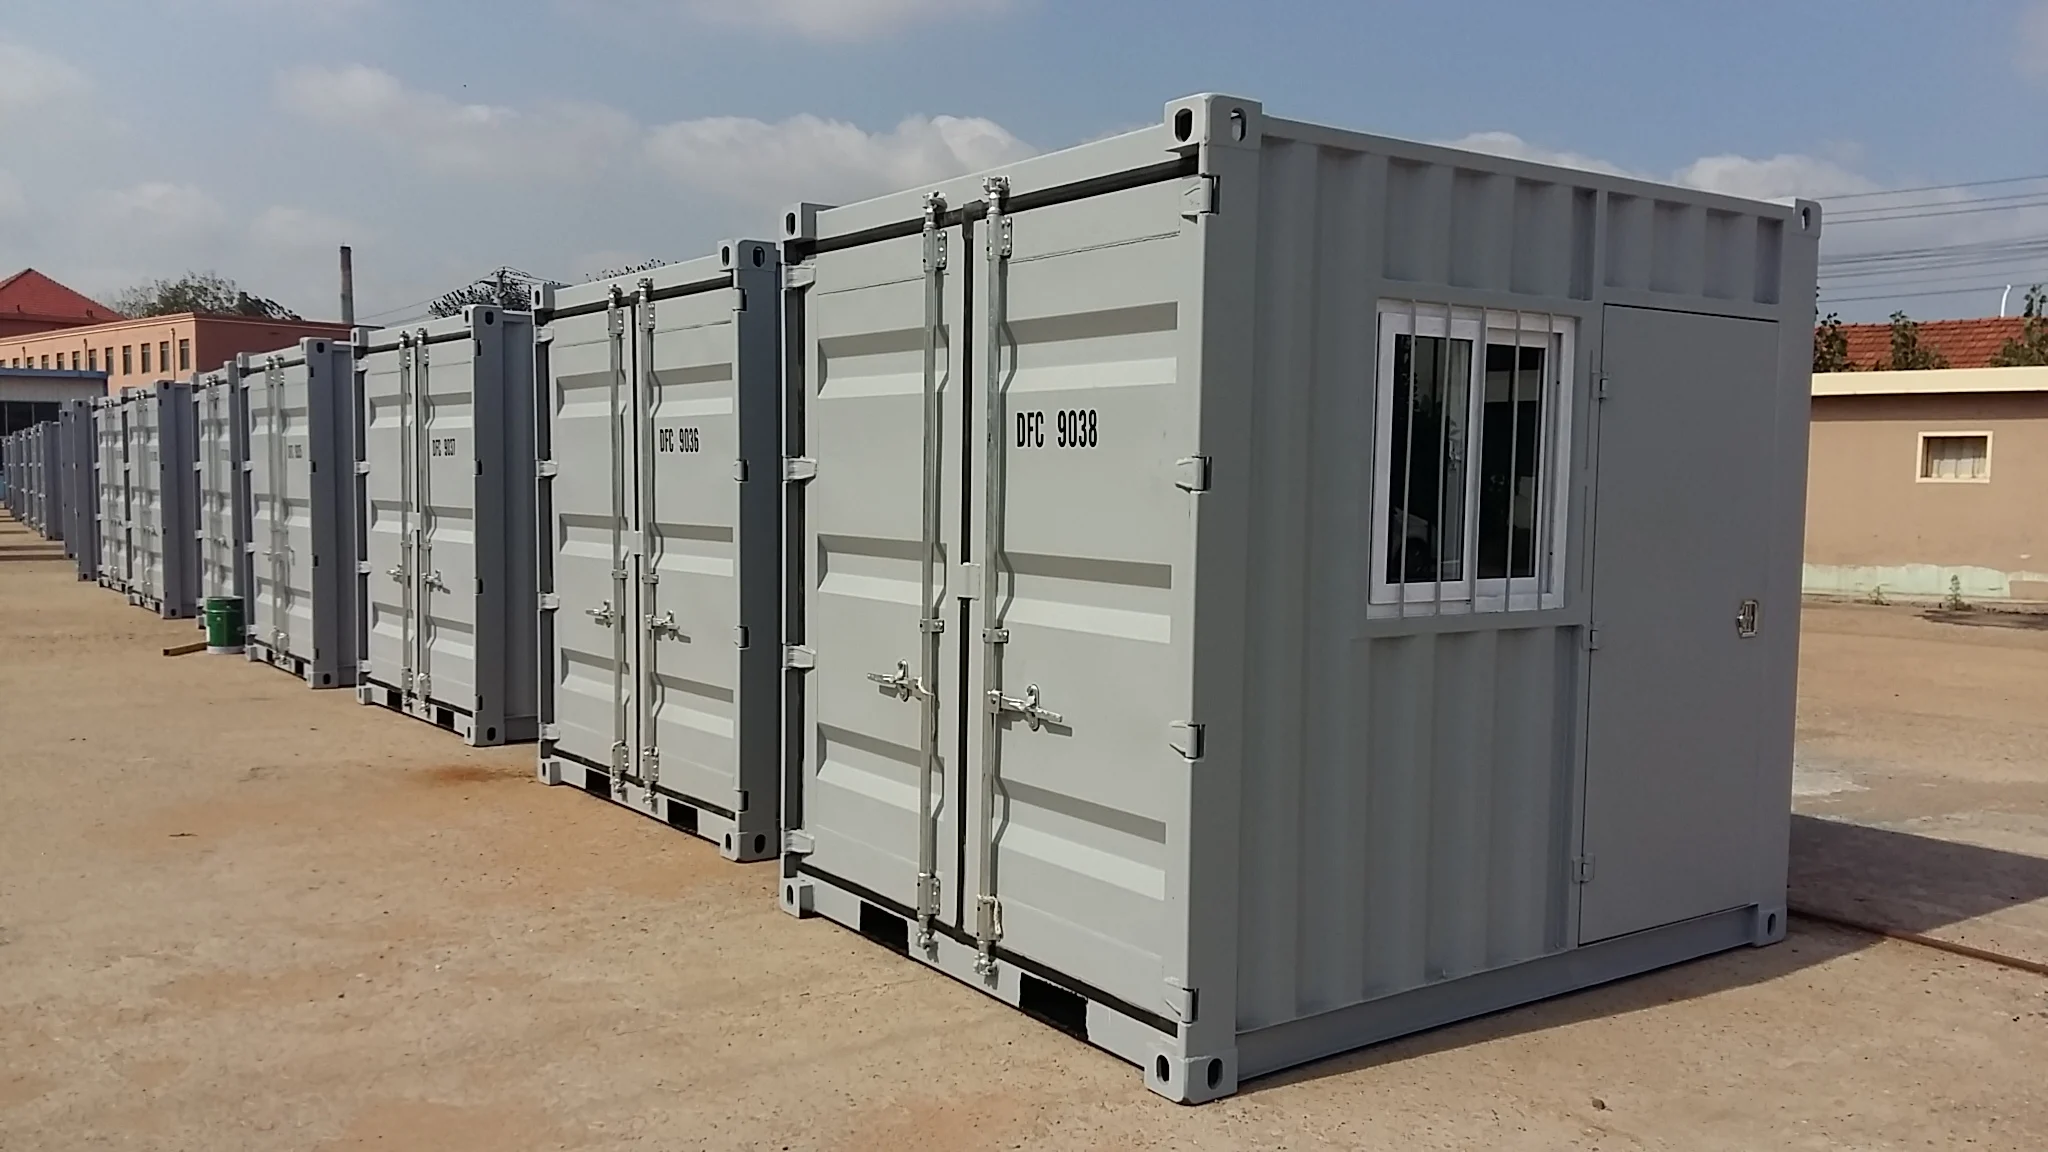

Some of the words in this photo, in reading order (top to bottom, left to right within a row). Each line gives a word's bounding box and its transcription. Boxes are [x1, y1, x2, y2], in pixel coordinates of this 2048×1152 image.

[659, 428, 674, 453] DFC
[679, 427, 699, 453] 9036
[1016, 411, 1044, 448] DFC
[1057, 409, 1098, 448] 9038
